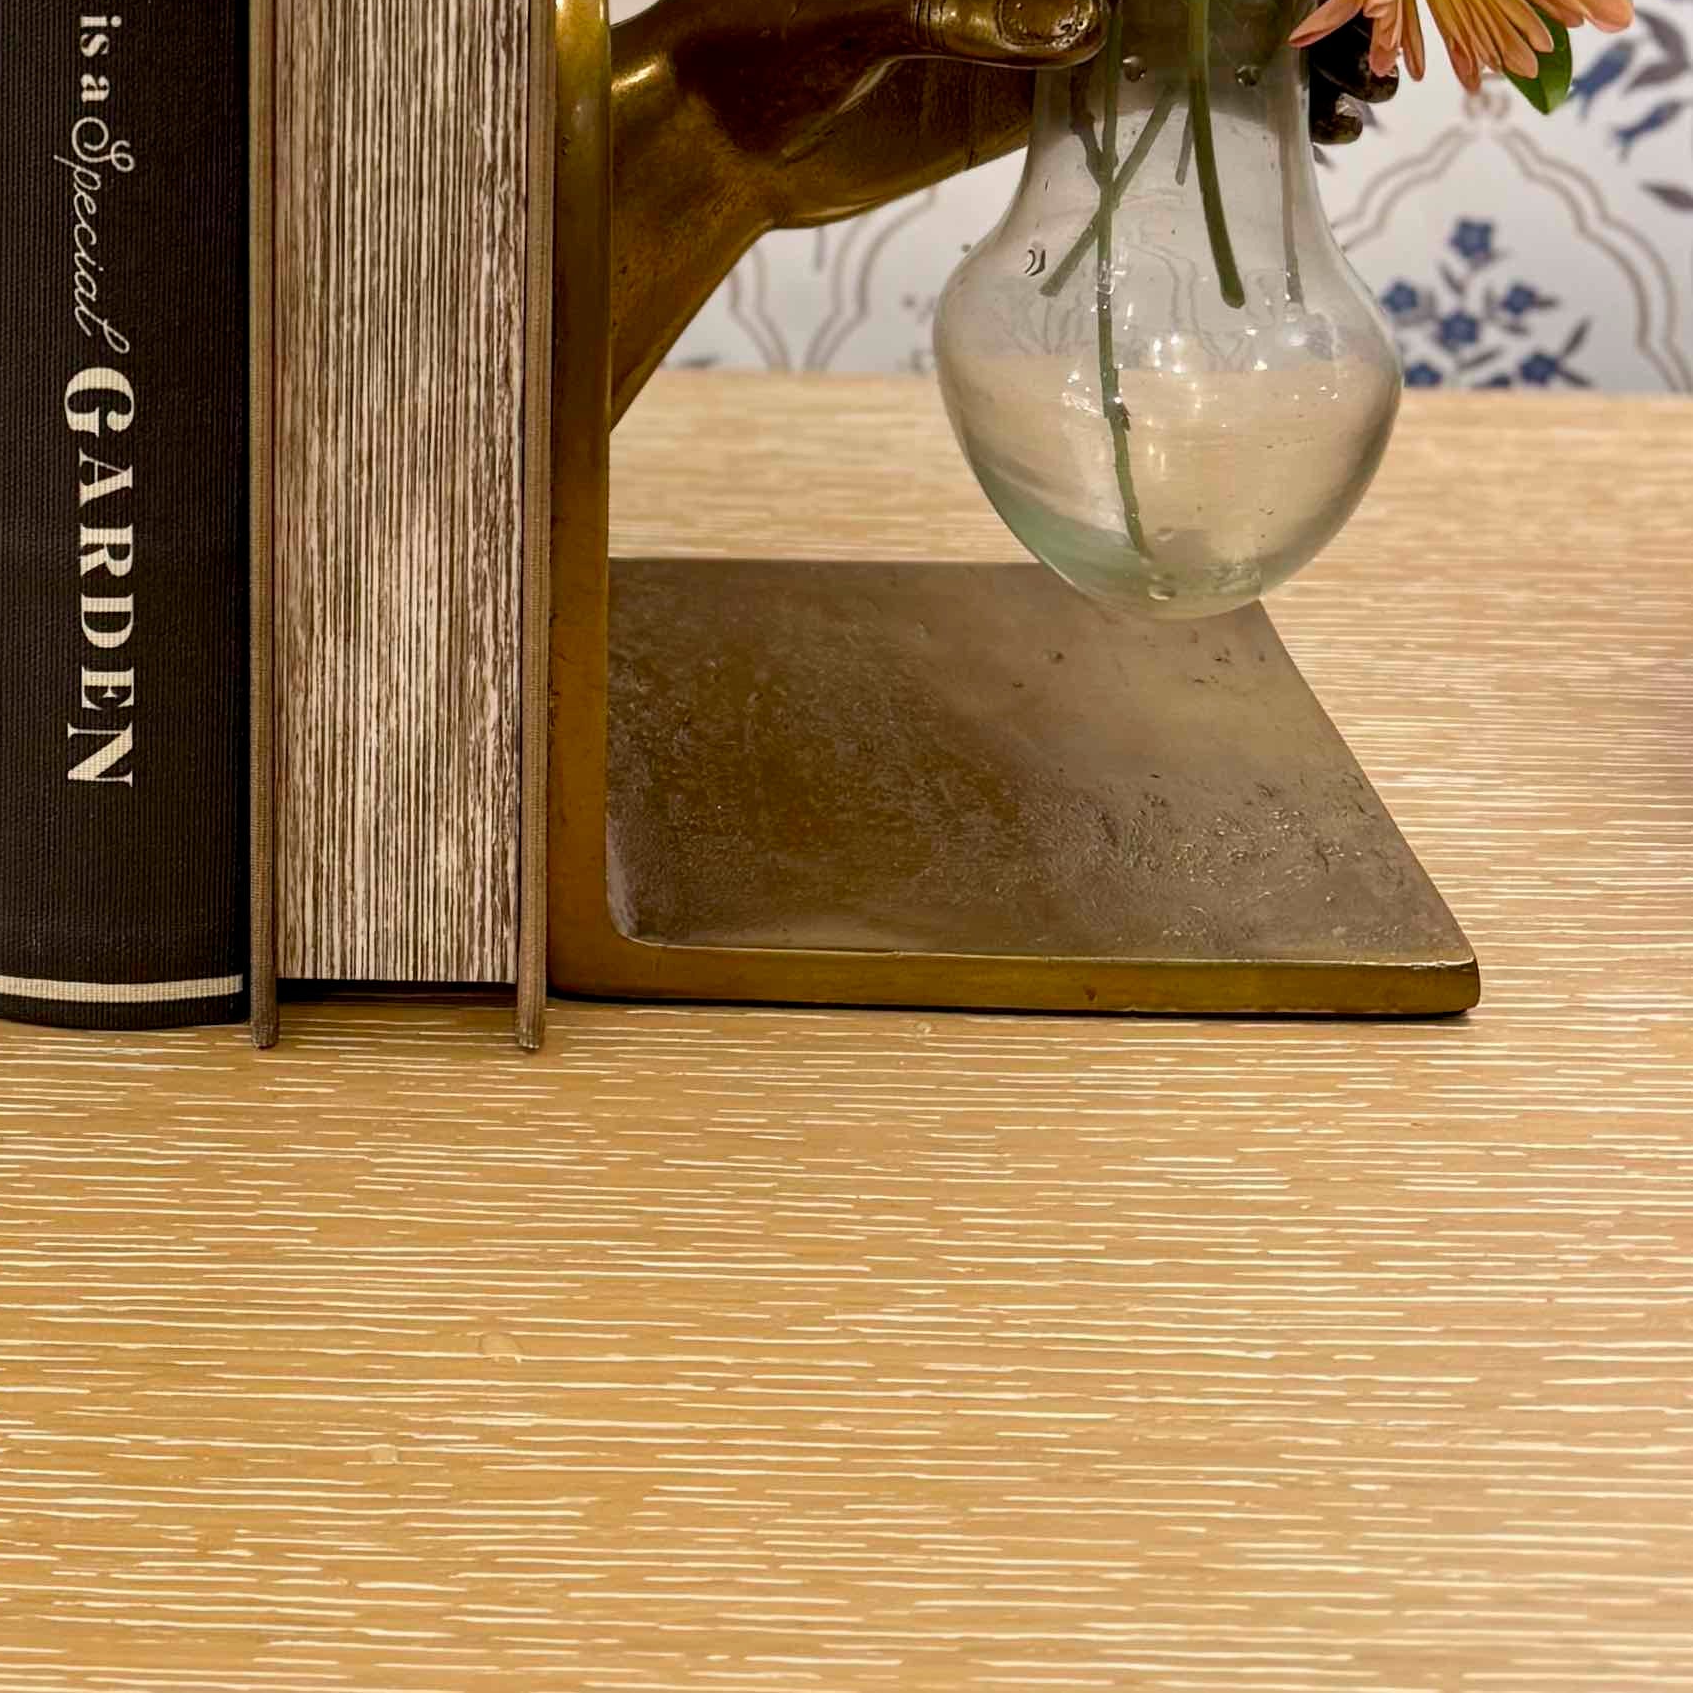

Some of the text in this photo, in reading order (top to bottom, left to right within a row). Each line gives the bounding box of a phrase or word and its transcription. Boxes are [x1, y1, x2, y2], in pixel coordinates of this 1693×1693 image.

[79, 15, 122, 58] is
[79, 73, 110, 103] a
[53, 116, 136, 354] Special
[64, 367, 136, 788] GARDEN
